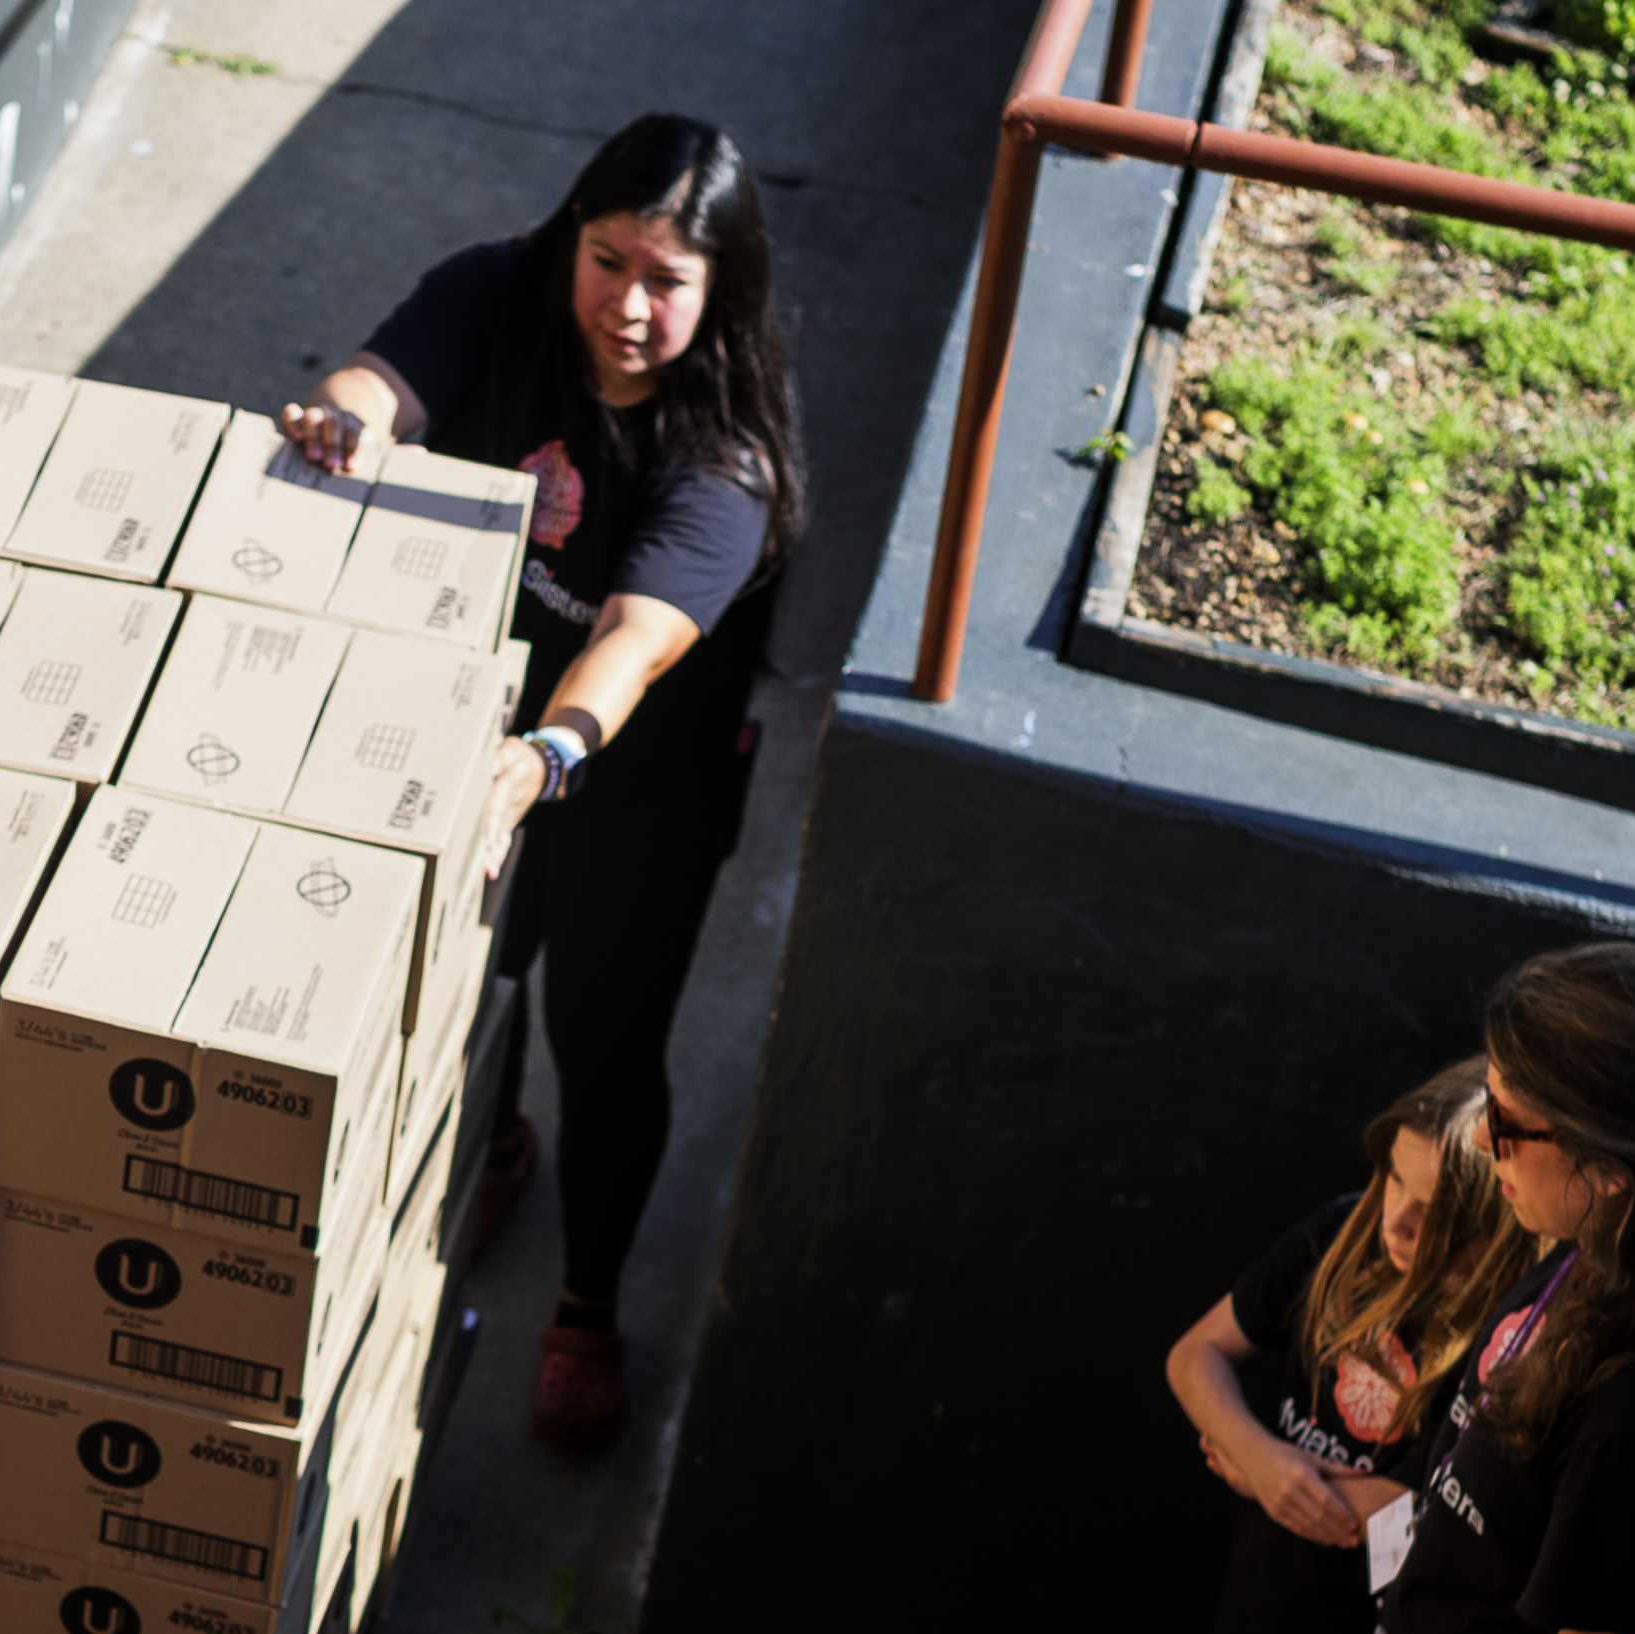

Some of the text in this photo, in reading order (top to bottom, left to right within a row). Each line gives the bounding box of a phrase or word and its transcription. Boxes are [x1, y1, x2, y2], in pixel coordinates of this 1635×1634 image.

[134, 1073, 173, 1117] U
[217, 1080, 310, 1118] 4906203
[119, 1253, 156, 1296] U
[203, 1259, 292, 1295] 4906203
[101, 1433, 138, 1476] U
[190, 1442, 277, 1478] 4906203
